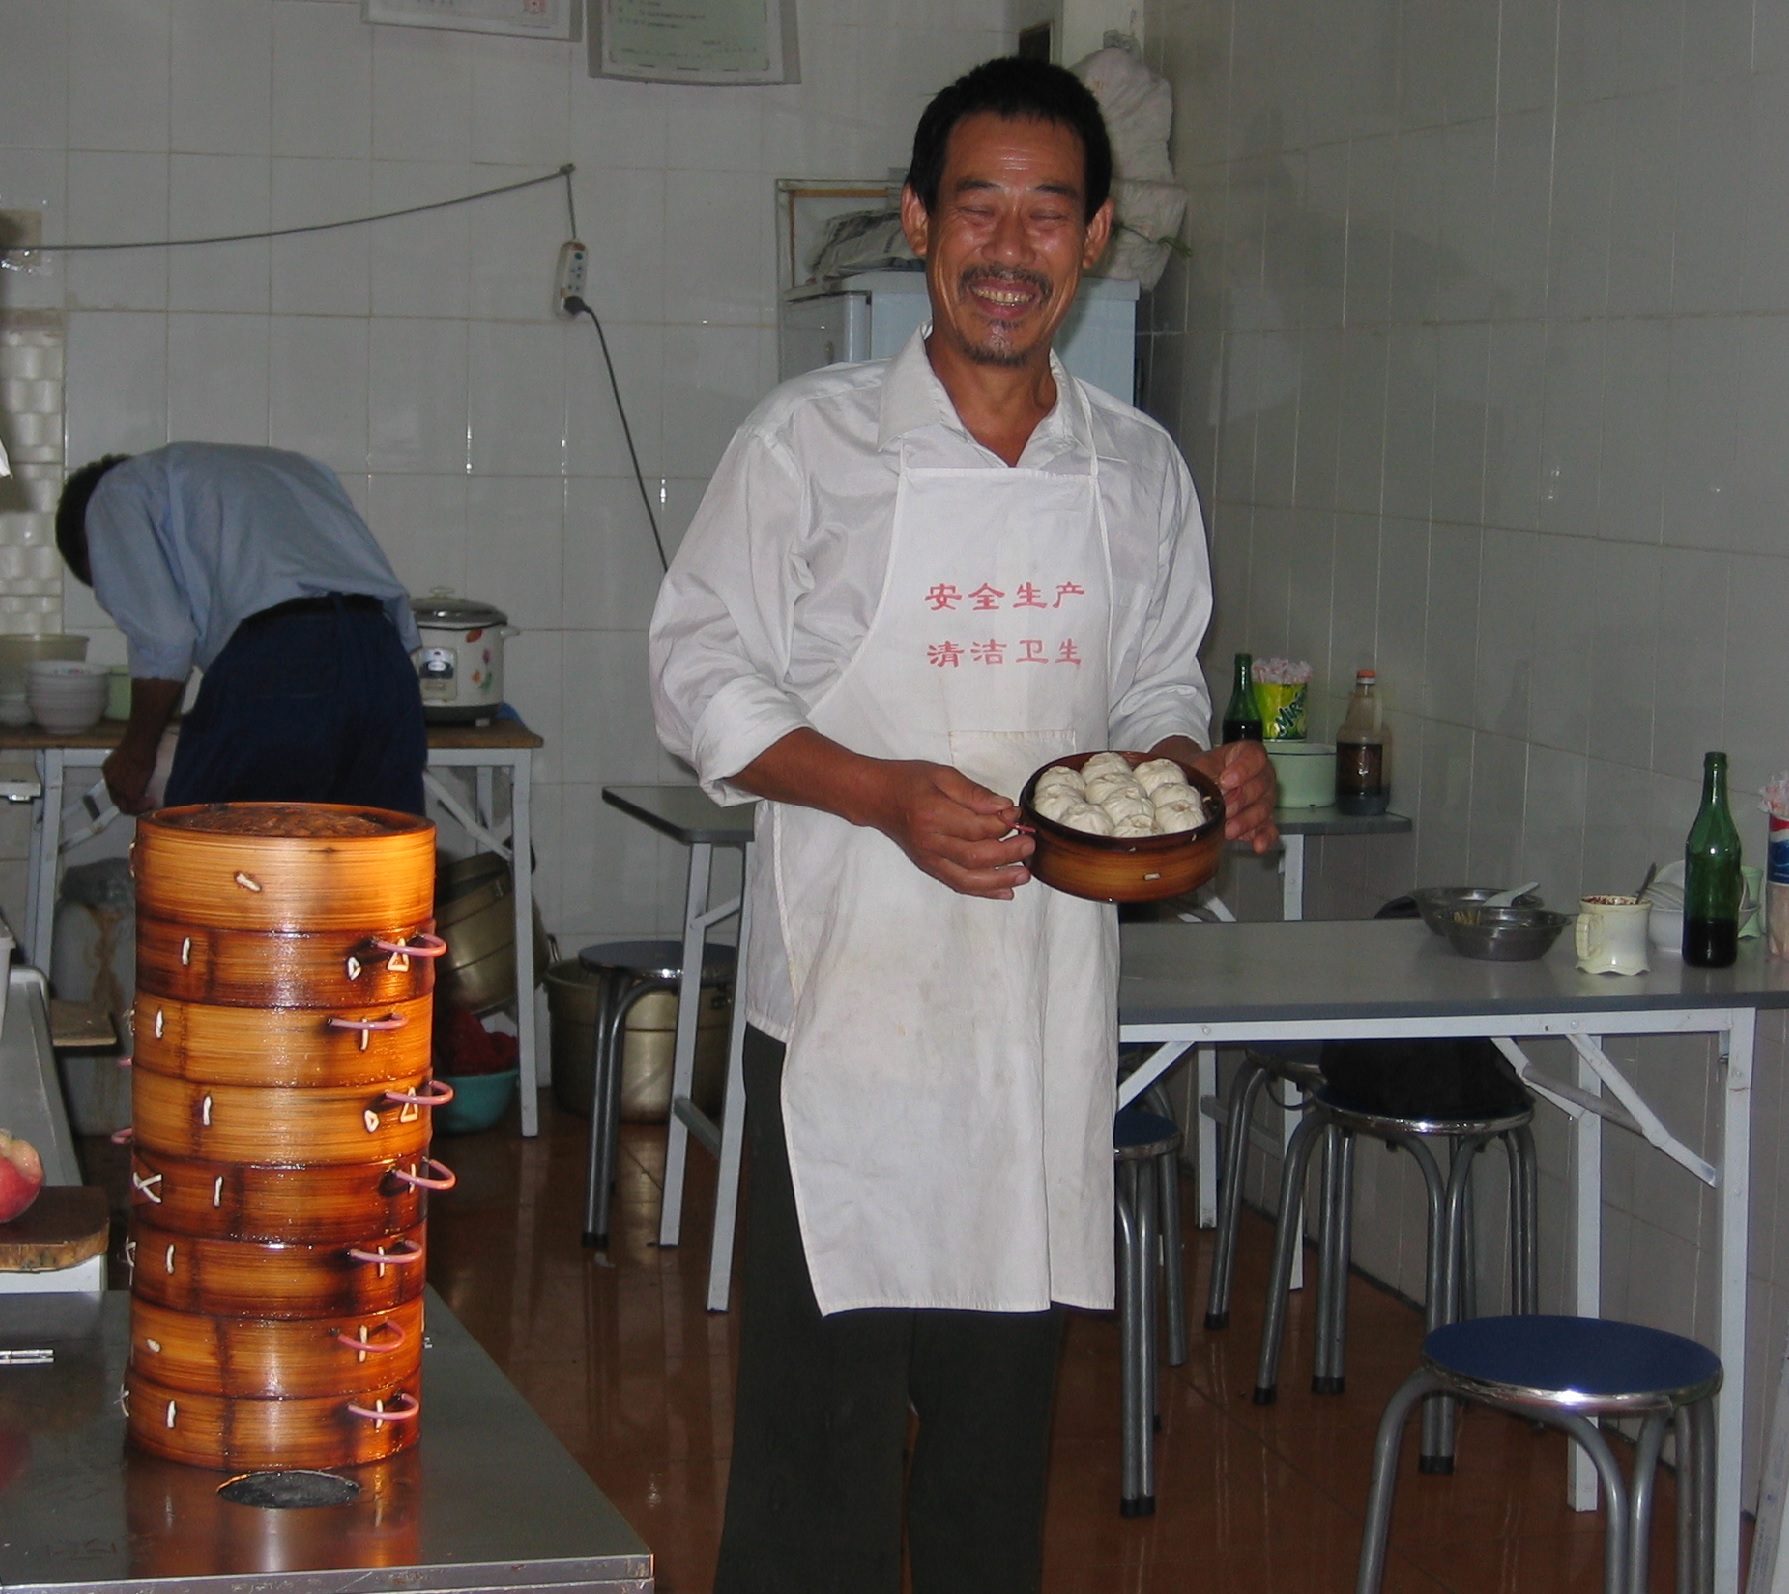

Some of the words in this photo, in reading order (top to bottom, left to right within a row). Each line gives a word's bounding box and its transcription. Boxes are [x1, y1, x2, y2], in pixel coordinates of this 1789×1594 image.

[924, 581, 1085, 611] 安全生产
[926, 638, 1082, 668] 清洁卫生
